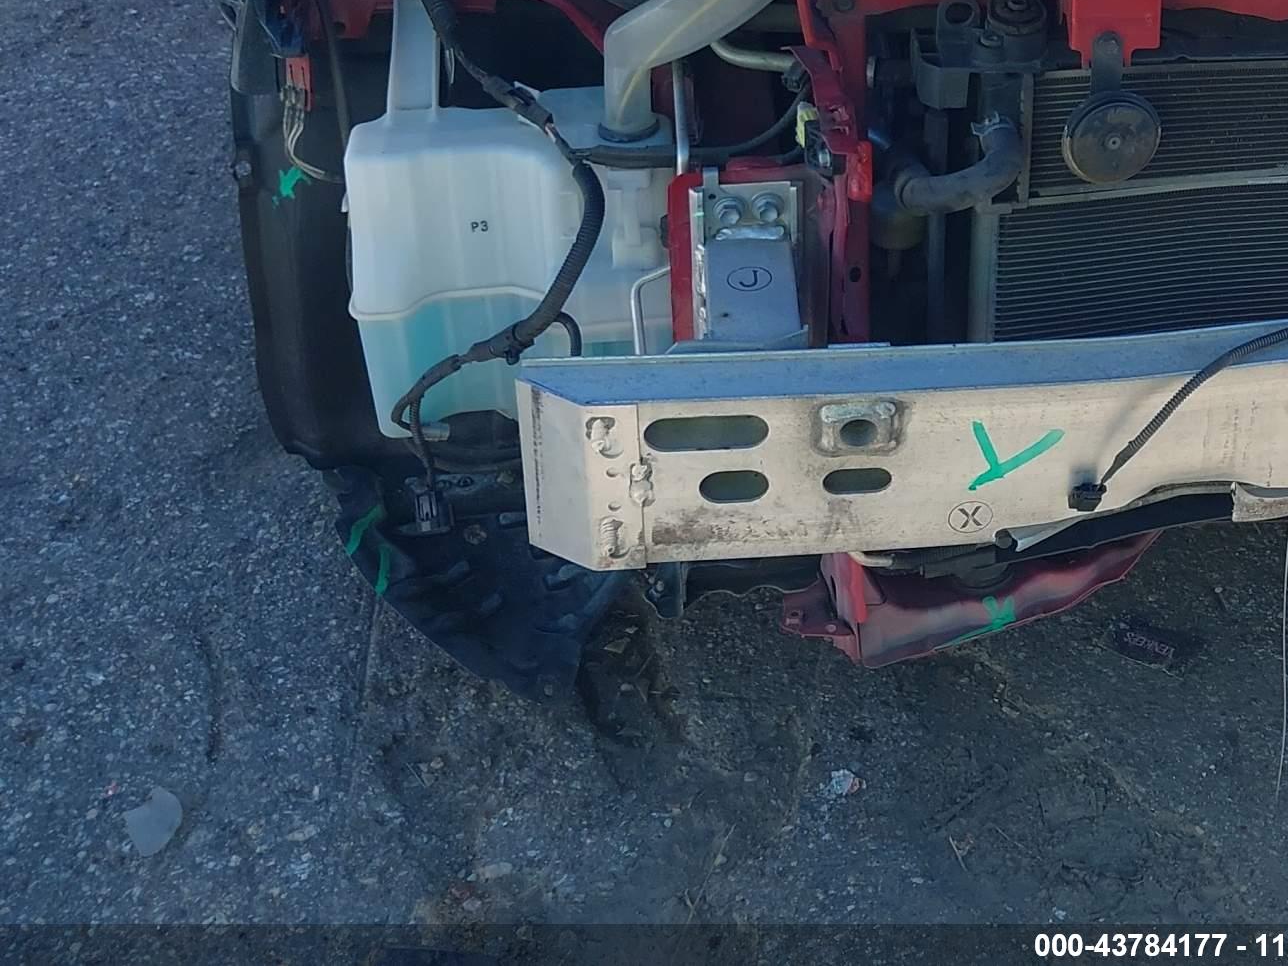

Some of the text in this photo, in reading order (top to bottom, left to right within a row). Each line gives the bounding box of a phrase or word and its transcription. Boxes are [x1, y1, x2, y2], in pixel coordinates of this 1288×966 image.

[471, 220, 489, 233] P3
[738, 269, 758, 288] J
[957, 506, 983, 530] X
